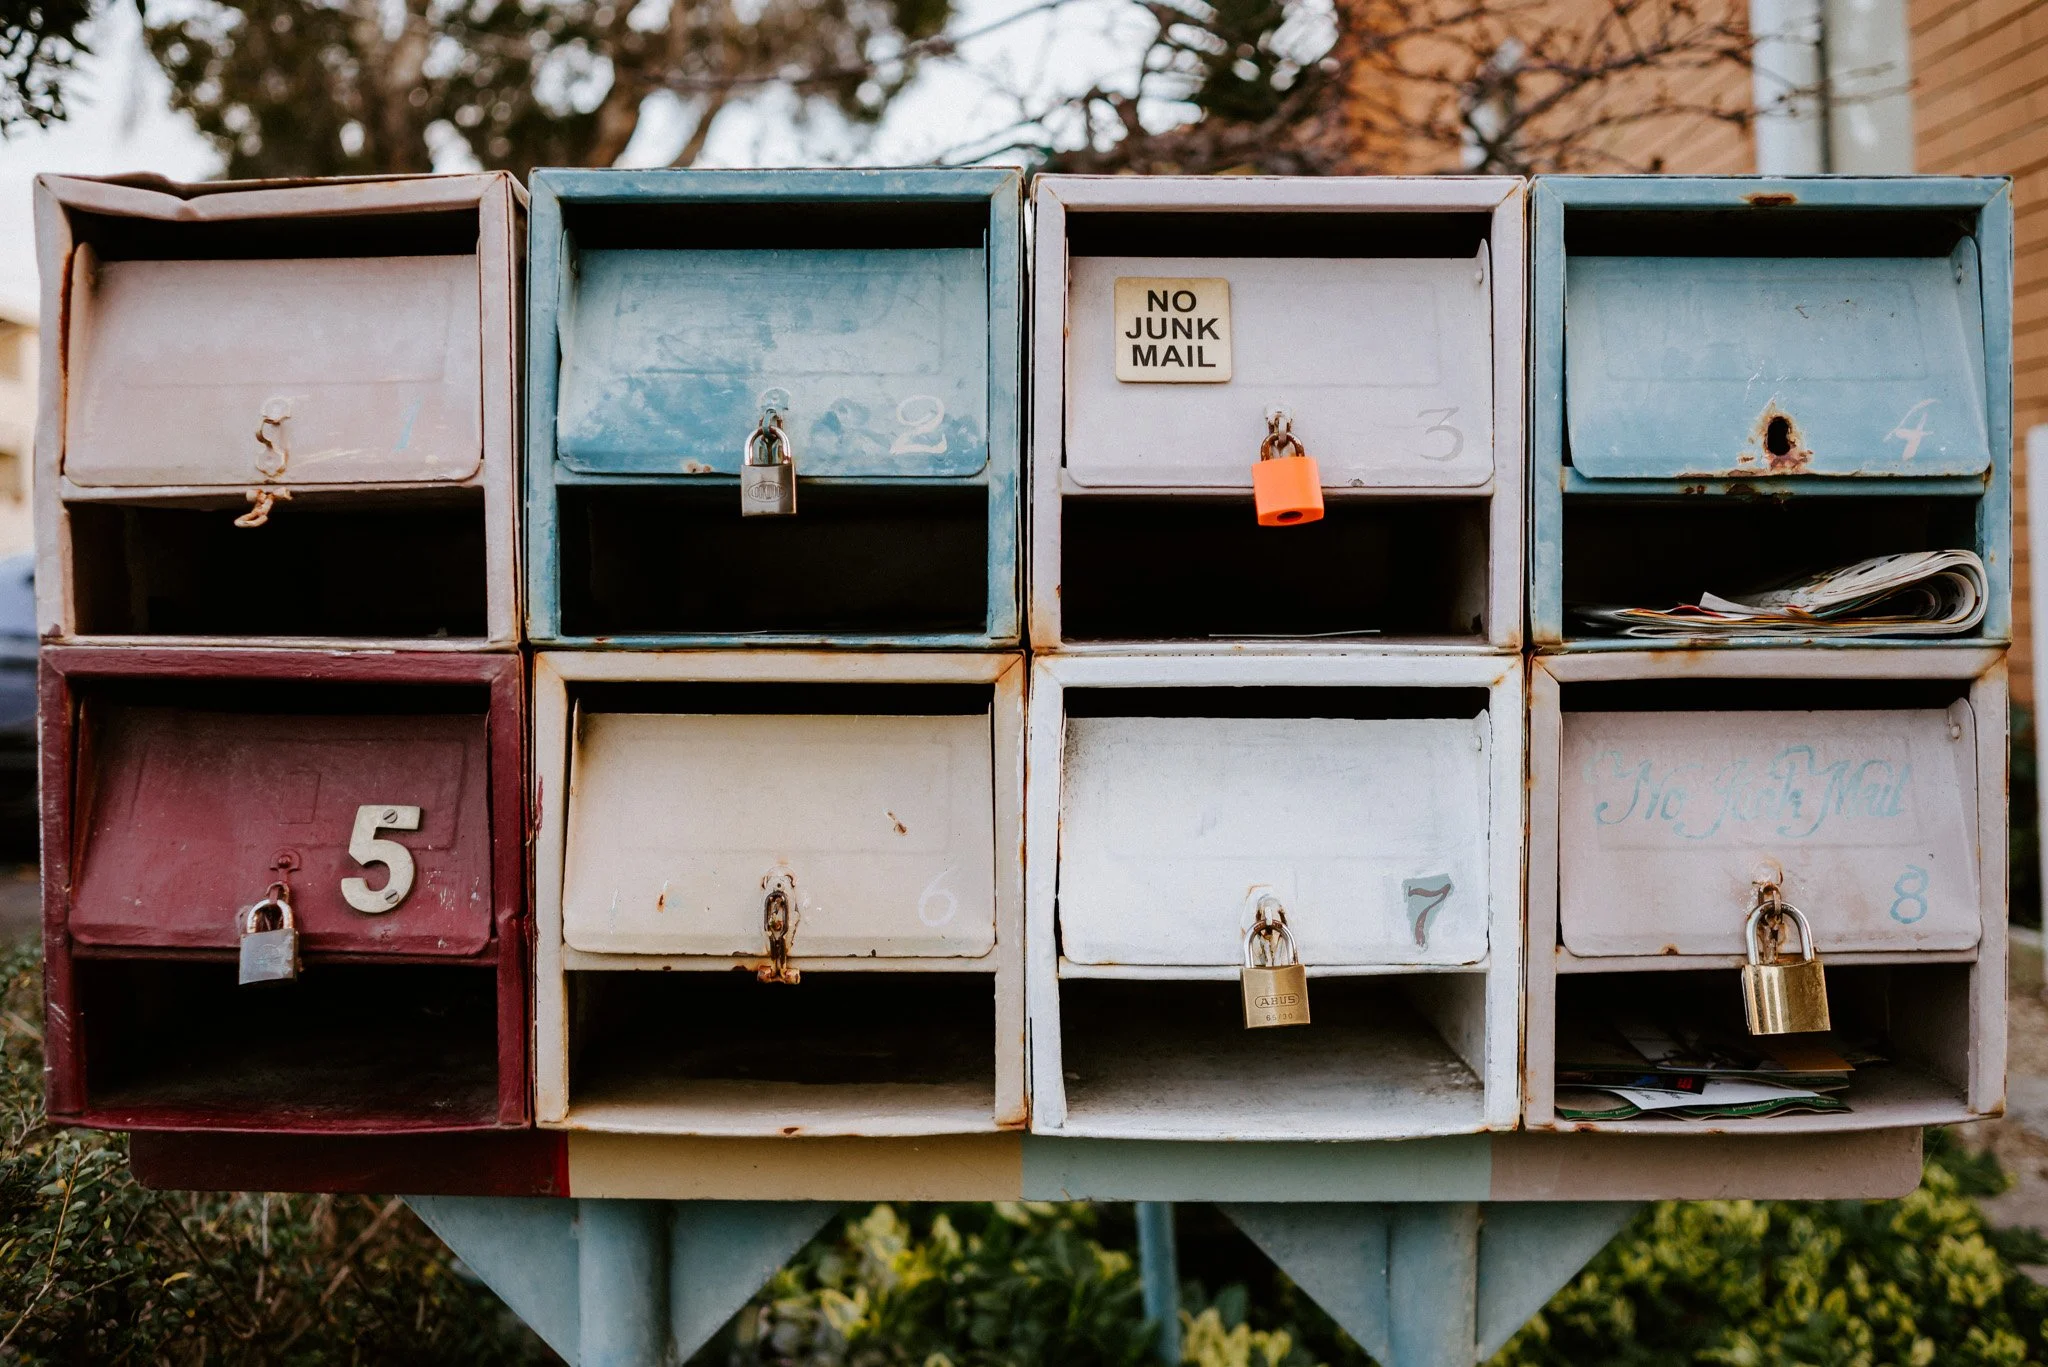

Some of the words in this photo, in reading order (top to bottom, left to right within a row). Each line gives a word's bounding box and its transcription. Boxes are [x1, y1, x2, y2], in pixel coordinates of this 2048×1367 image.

[1125, 317, 1220, 340] JUNK
[1147, 290, 1197, 312] NO
[1132, 345, 1217, 367] MAIL
[889, 394, 947, 455] 2
[1416, 406, 1464, 461] 3
[1883, 398, 1937, 461] 4
[1583, 750, 1703, 825] No
[1768, 744, 1913, 838] Mail
[341, 805, 421, 914] 5
[918, 870, 958, 927] 6
[1406, 880, 1452, 948] 7
[1889, 864, 1929, 925] 8
[1260, 995, 1297, 1007] ABUS
